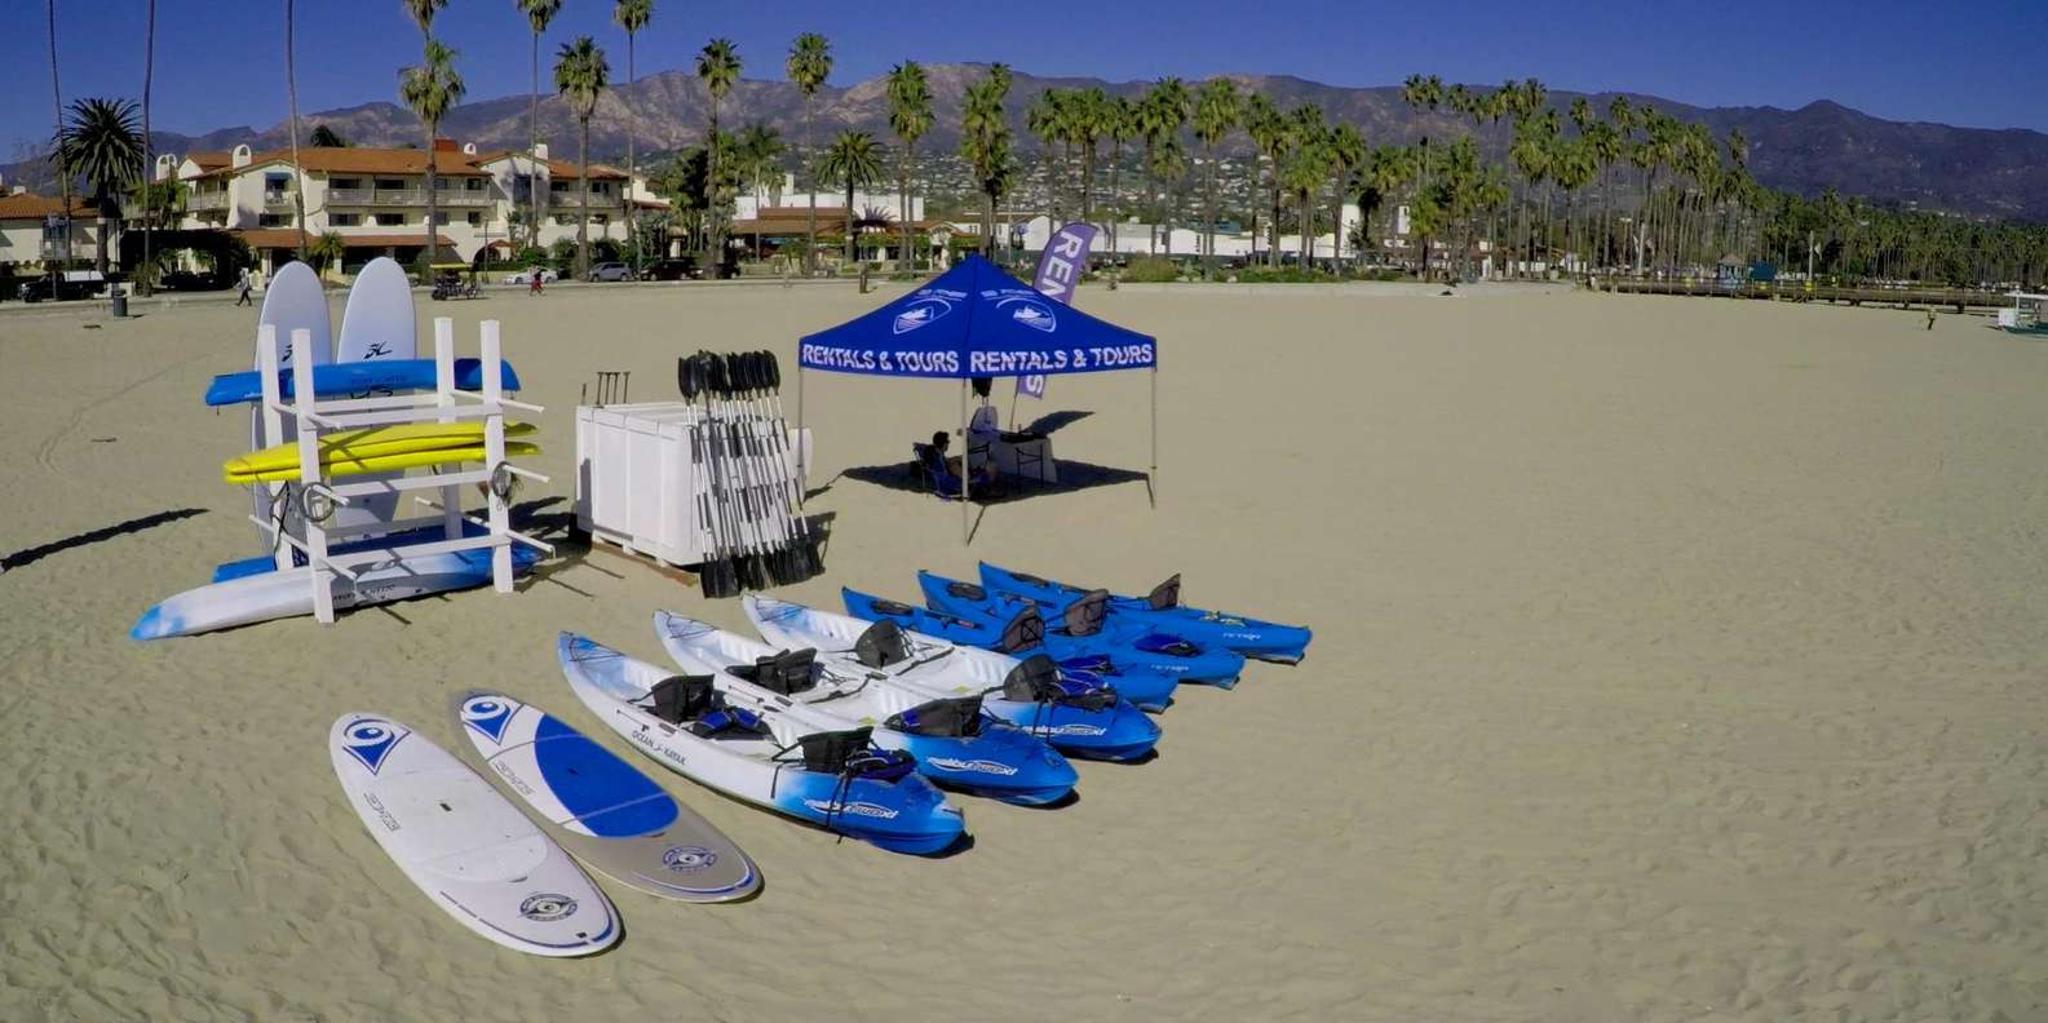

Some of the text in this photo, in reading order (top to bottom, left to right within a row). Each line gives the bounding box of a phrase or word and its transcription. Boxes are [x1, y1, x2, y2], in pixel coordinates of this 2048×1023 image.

[802, 343, 959, 373] RENTALS & TOURS
[970, 344, 1153, 373] RENTALS & TOURS
